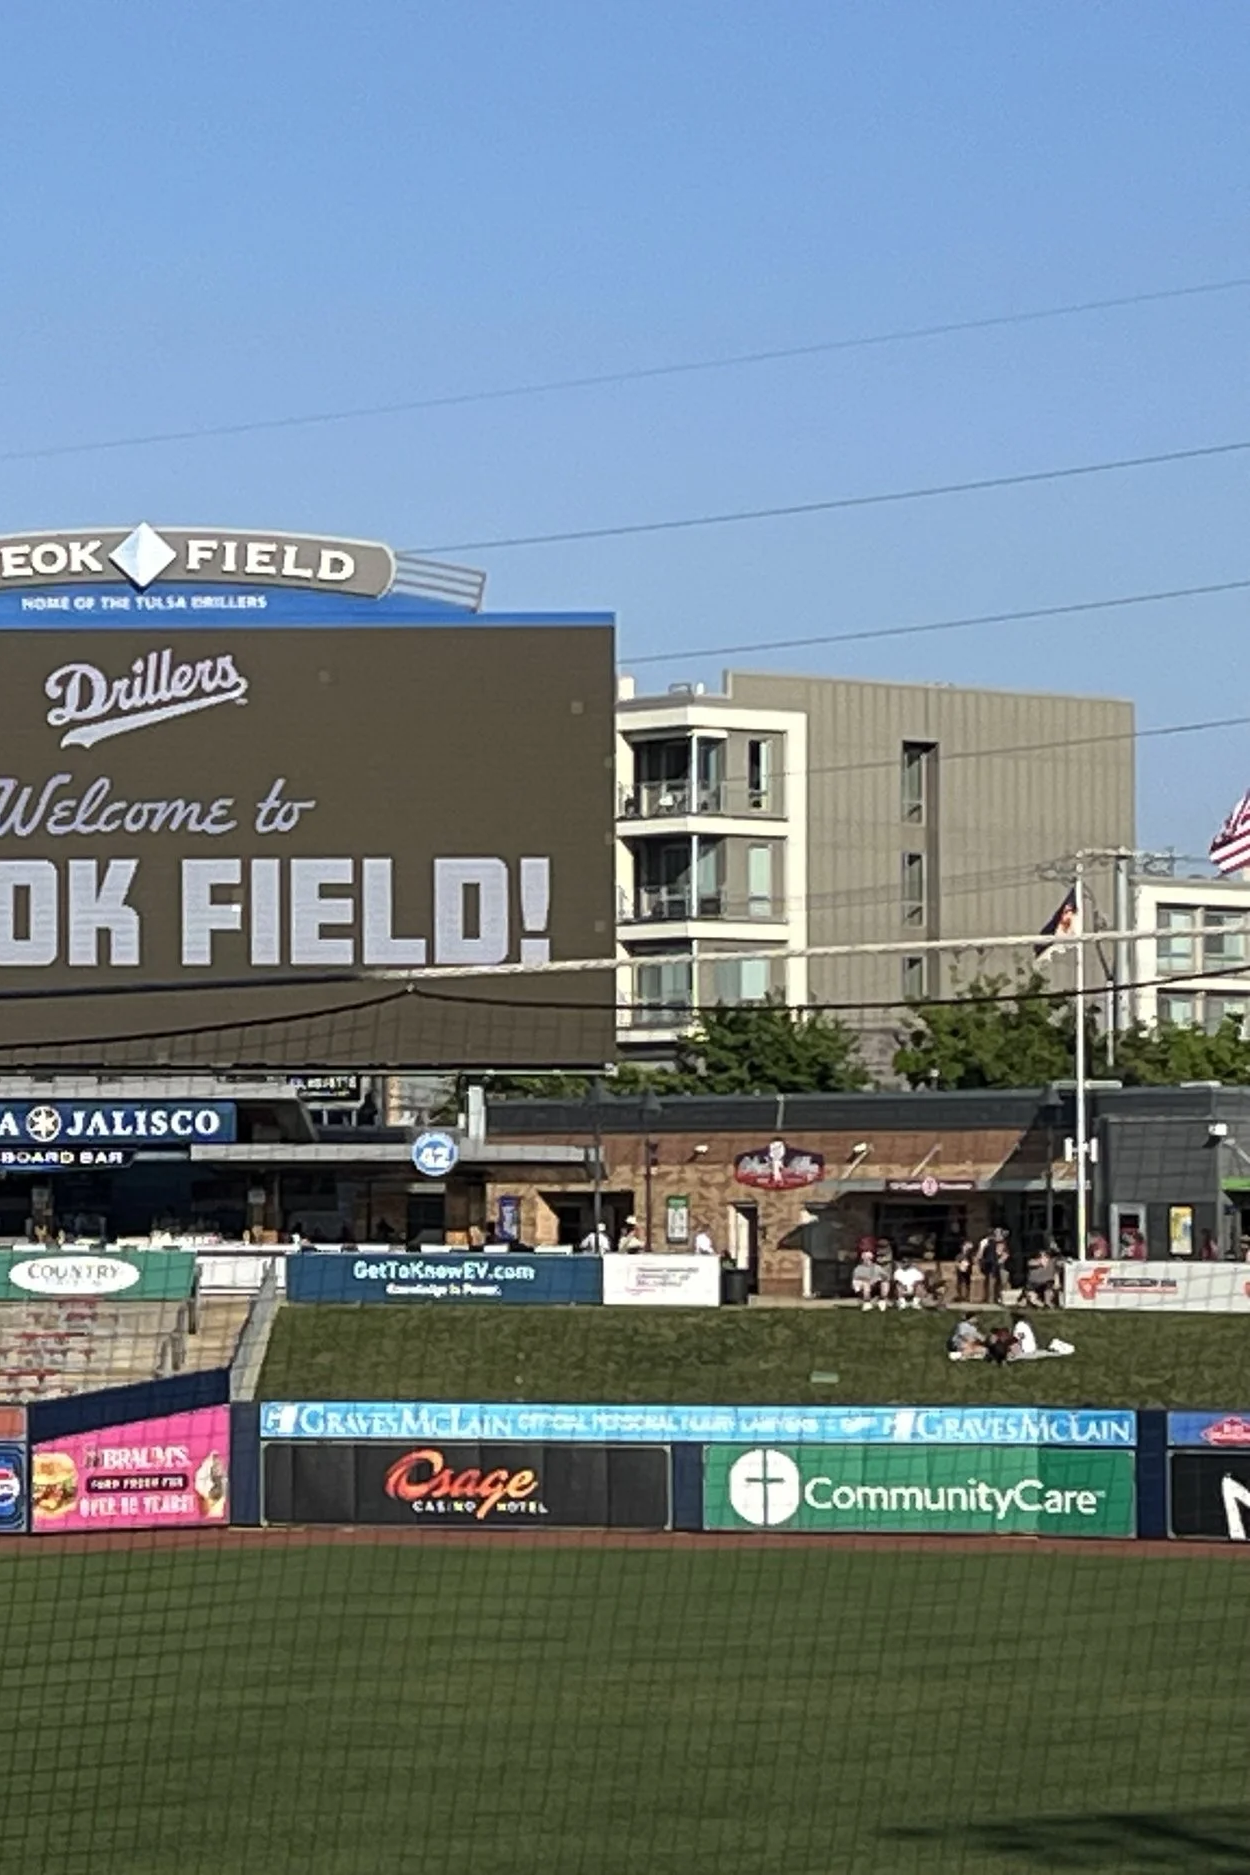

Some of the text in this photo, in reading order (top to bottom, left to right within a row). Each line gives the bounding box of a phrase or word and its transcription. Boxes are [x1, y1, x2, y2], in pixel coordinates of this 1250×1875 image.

[185, 539, 356, 581] FIELD
[20, 596, 268, 611] HOME OF THE TULSA DRILLERS
[45, 649, 248, 736] Drillers
[253, 778, 315, 836] to
[181, 857, 551, 968] FIELD!
[65, 1109, 221, 1137] JALISCO
[79, 1150, 124, 1165] BAR
[421, 1147, 450, 1168] 42
[27, 1262, 120, 1280] COUNTRY
[353, 1260, 536, 1281] GetToKnowEV.com
[383, 1449, 539, 1520] Osage
[804, 1477, 1098, 1519] CommunityCare
[412, 1501, 476, 1513] CASINO
